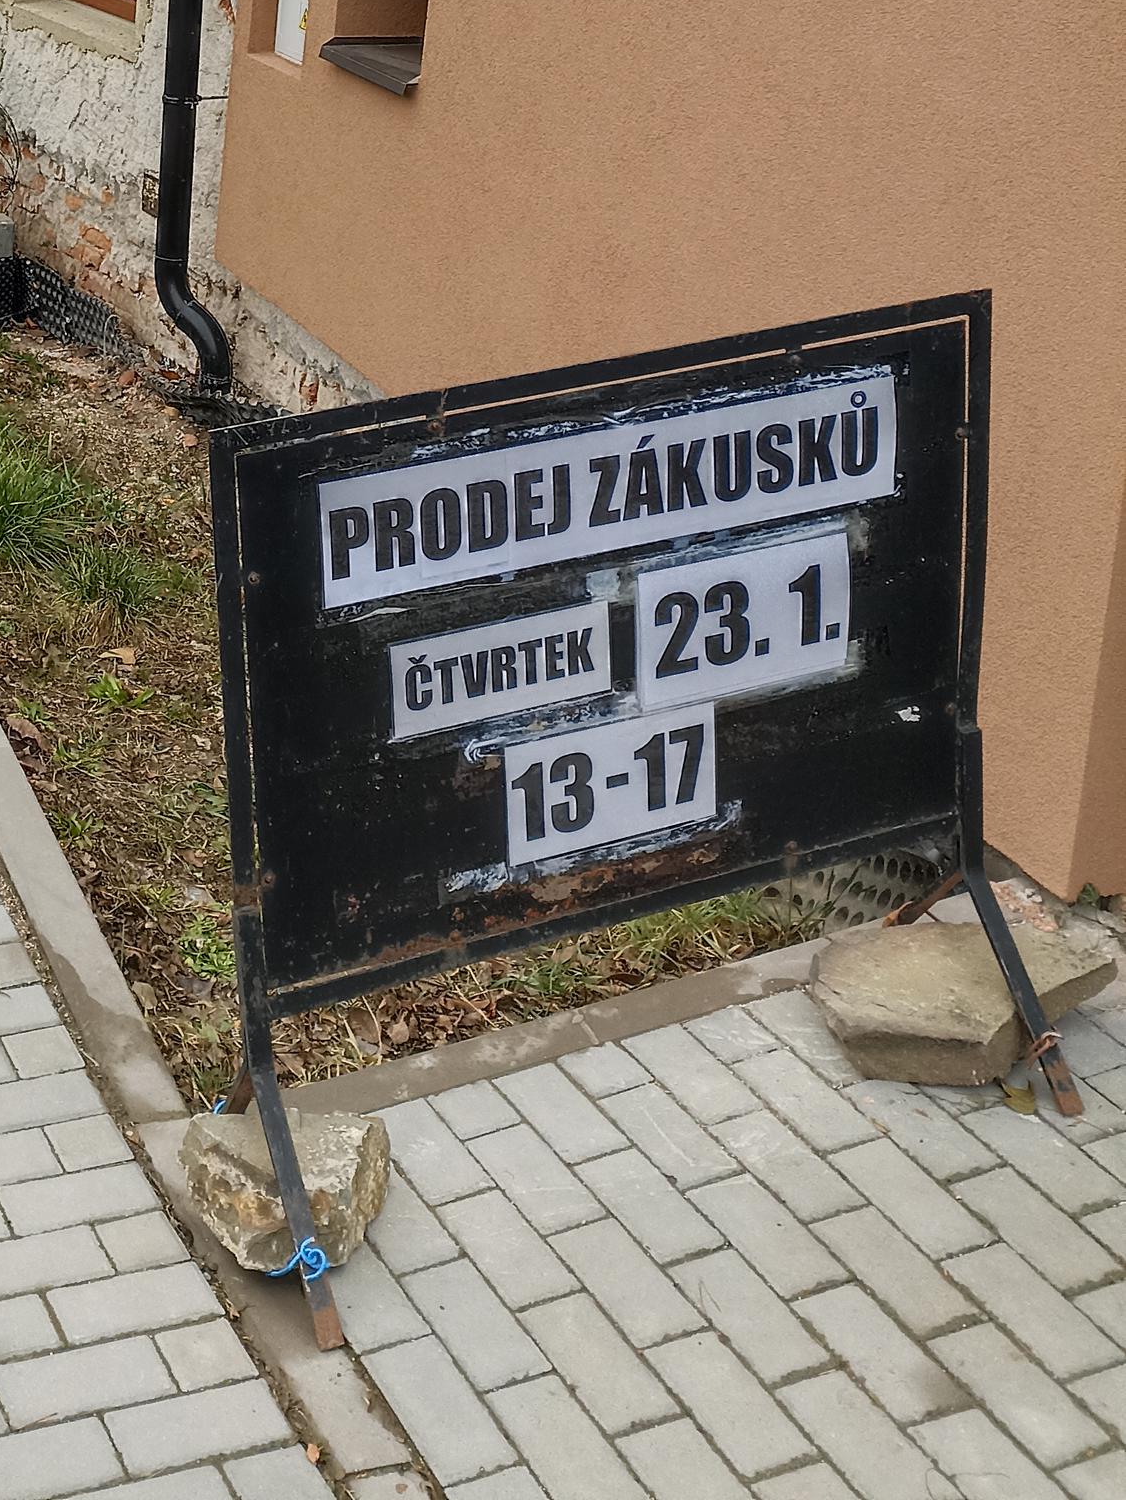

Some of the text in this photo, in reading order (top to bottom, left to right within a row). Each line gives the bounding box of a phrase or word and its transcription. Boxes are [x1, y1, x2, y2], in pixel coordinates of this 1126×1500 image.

[329, 391, 879, 581] PRODEJ ZÁKUSKŮ
[404, 563, 841, 712] ČTVRTEK 23. 1.
